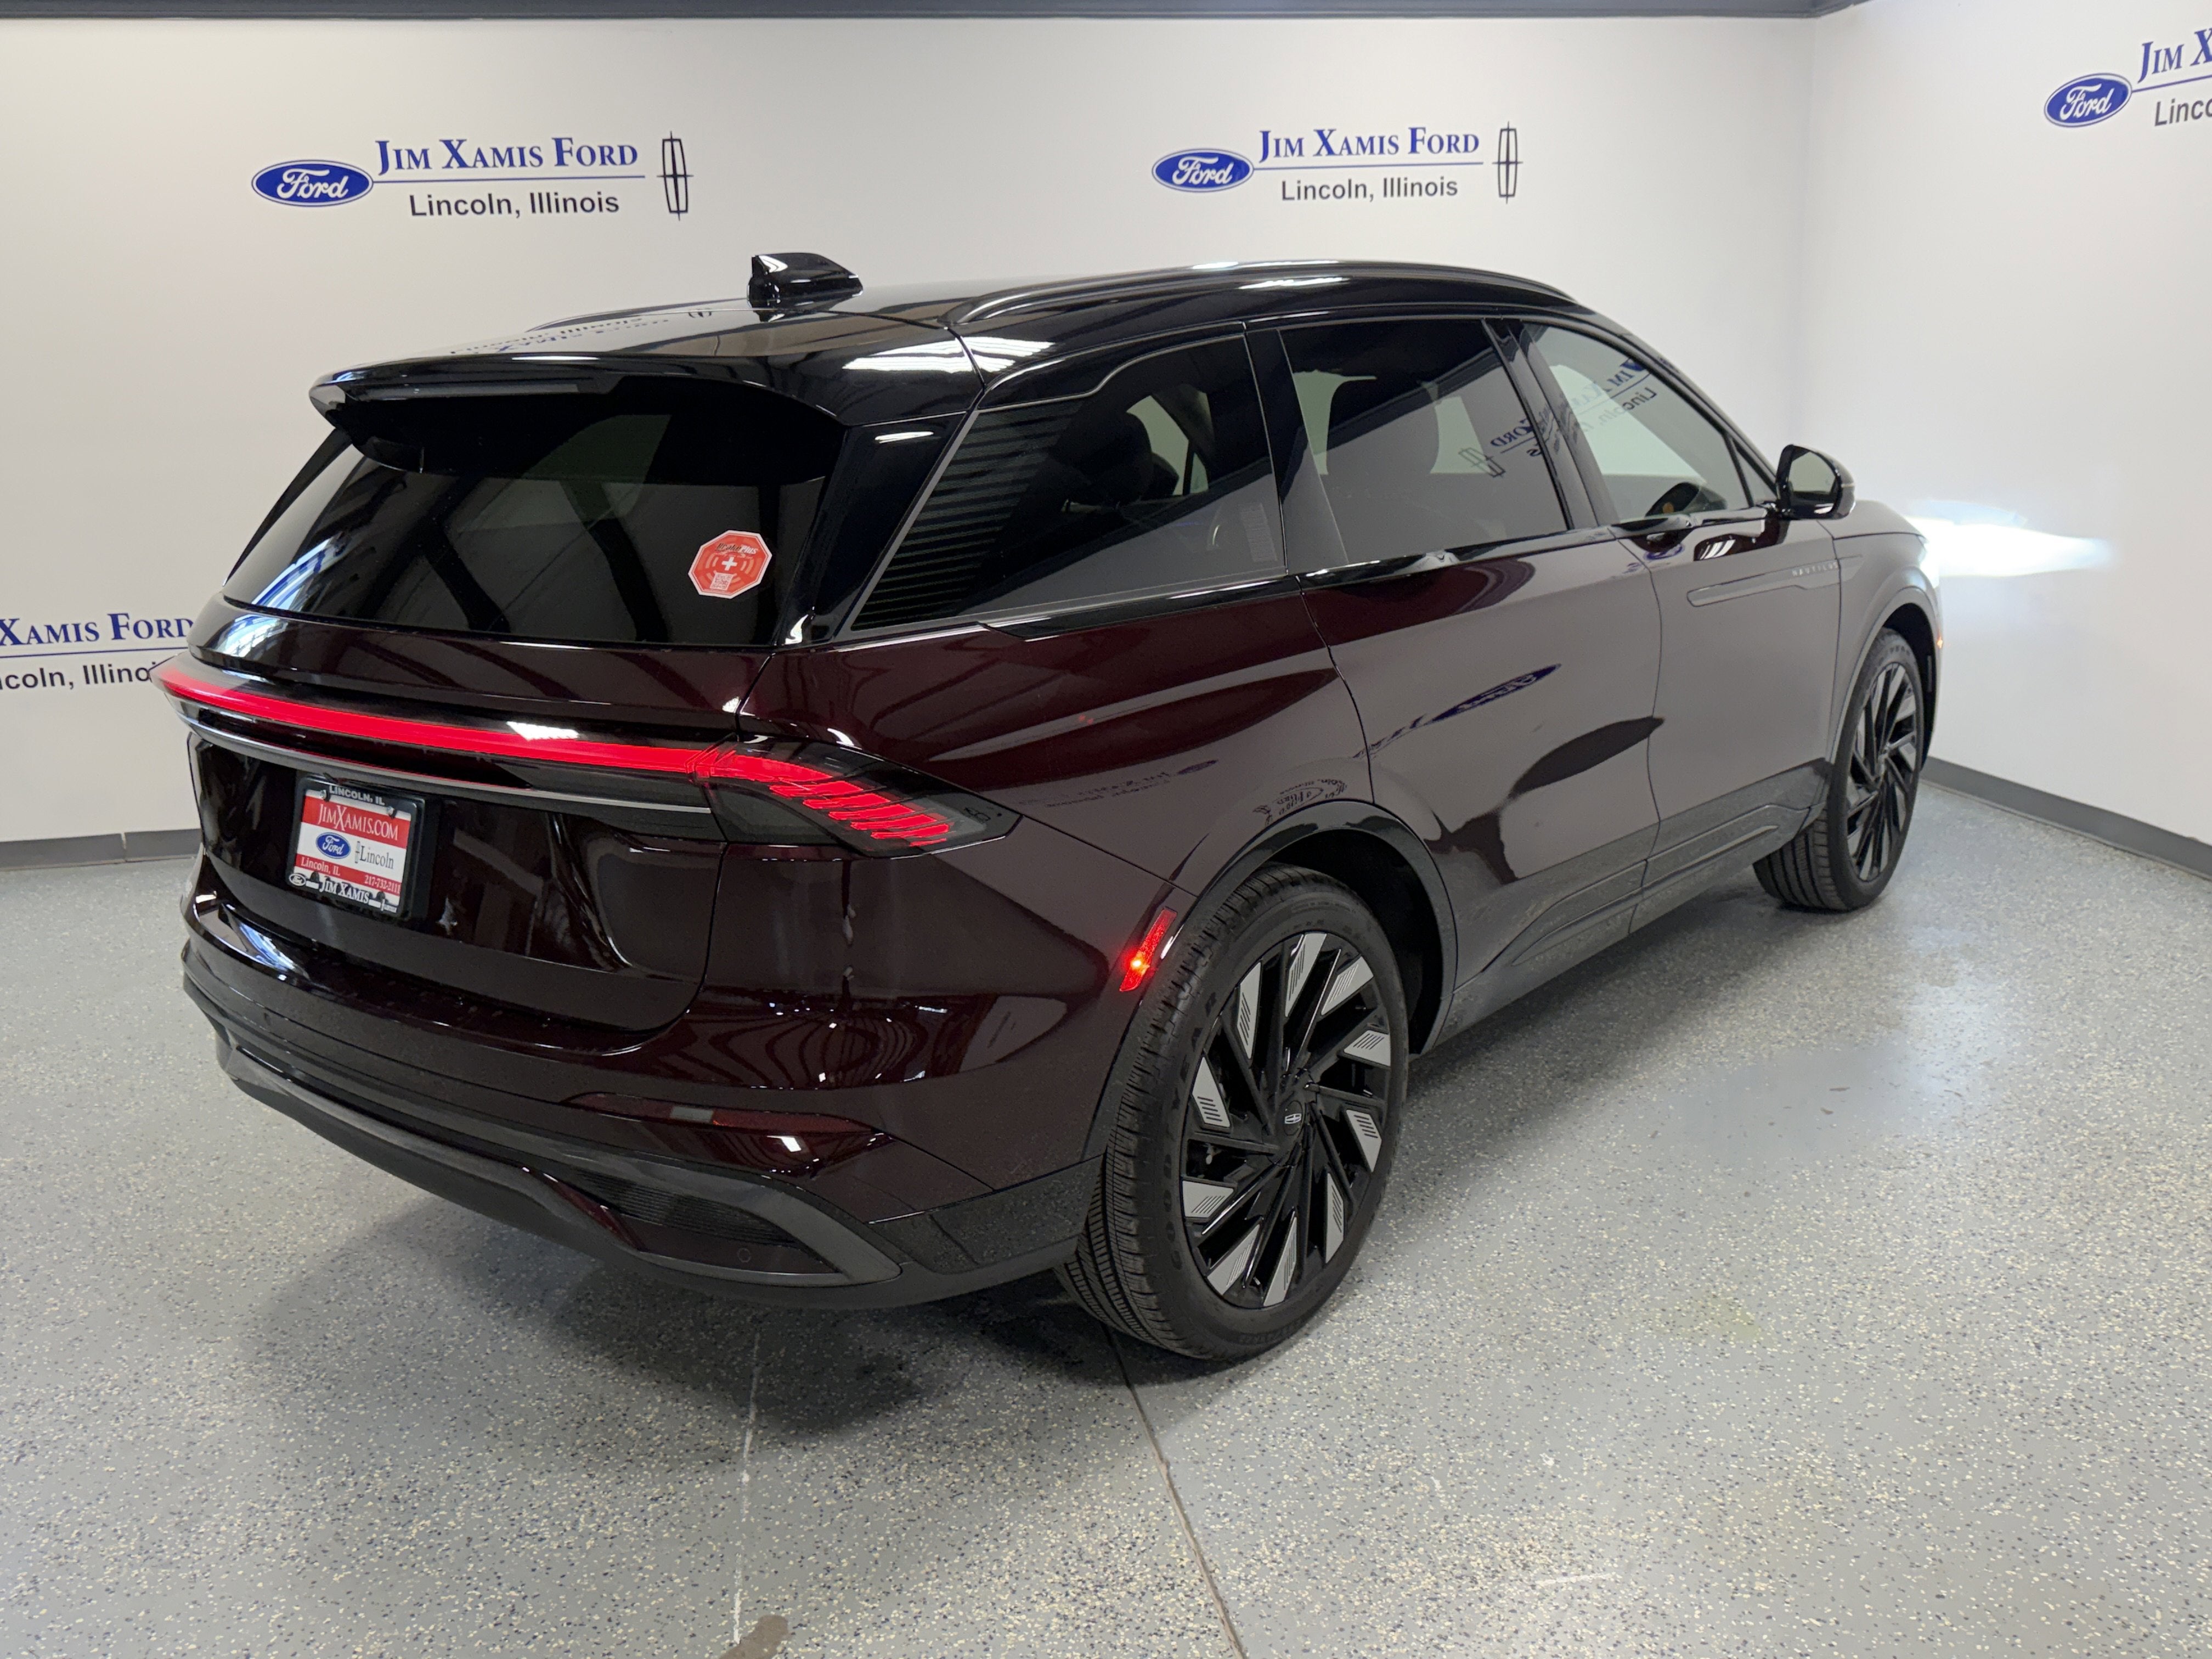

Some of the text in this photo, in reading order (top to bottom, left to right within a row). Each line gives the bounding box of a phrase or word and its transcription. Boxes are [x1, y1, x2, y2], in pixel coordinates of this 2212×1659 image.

[2136, 41, 2185, 84] JIM
[2059, 83, 2115, 121] Ford
[375, 137, 639, 176] JIM XAMIS FORD
[1259, 127, 1480, 163] JIM XAMIS FORD
[276, 168, 349, 200] Ford
[1171, 156, 1233, 186] Ford
[1282, 177, 1458, 202] Lincoln, Illinois
[409, 191, 620, 219] Lincoln, Illinois
[83, 661, 156, 685] Illino
[329, 786, 385, 805] LINCOLN, IL
[318, 803, 398, 840] JIMXAMIS.COM
[322, 835, 343, 855] Ford
[359, 845, 394, 869] Lincoln
[332, 866, 341, 876] IL
[319, 879, 370, 904] JIM XAMIS
